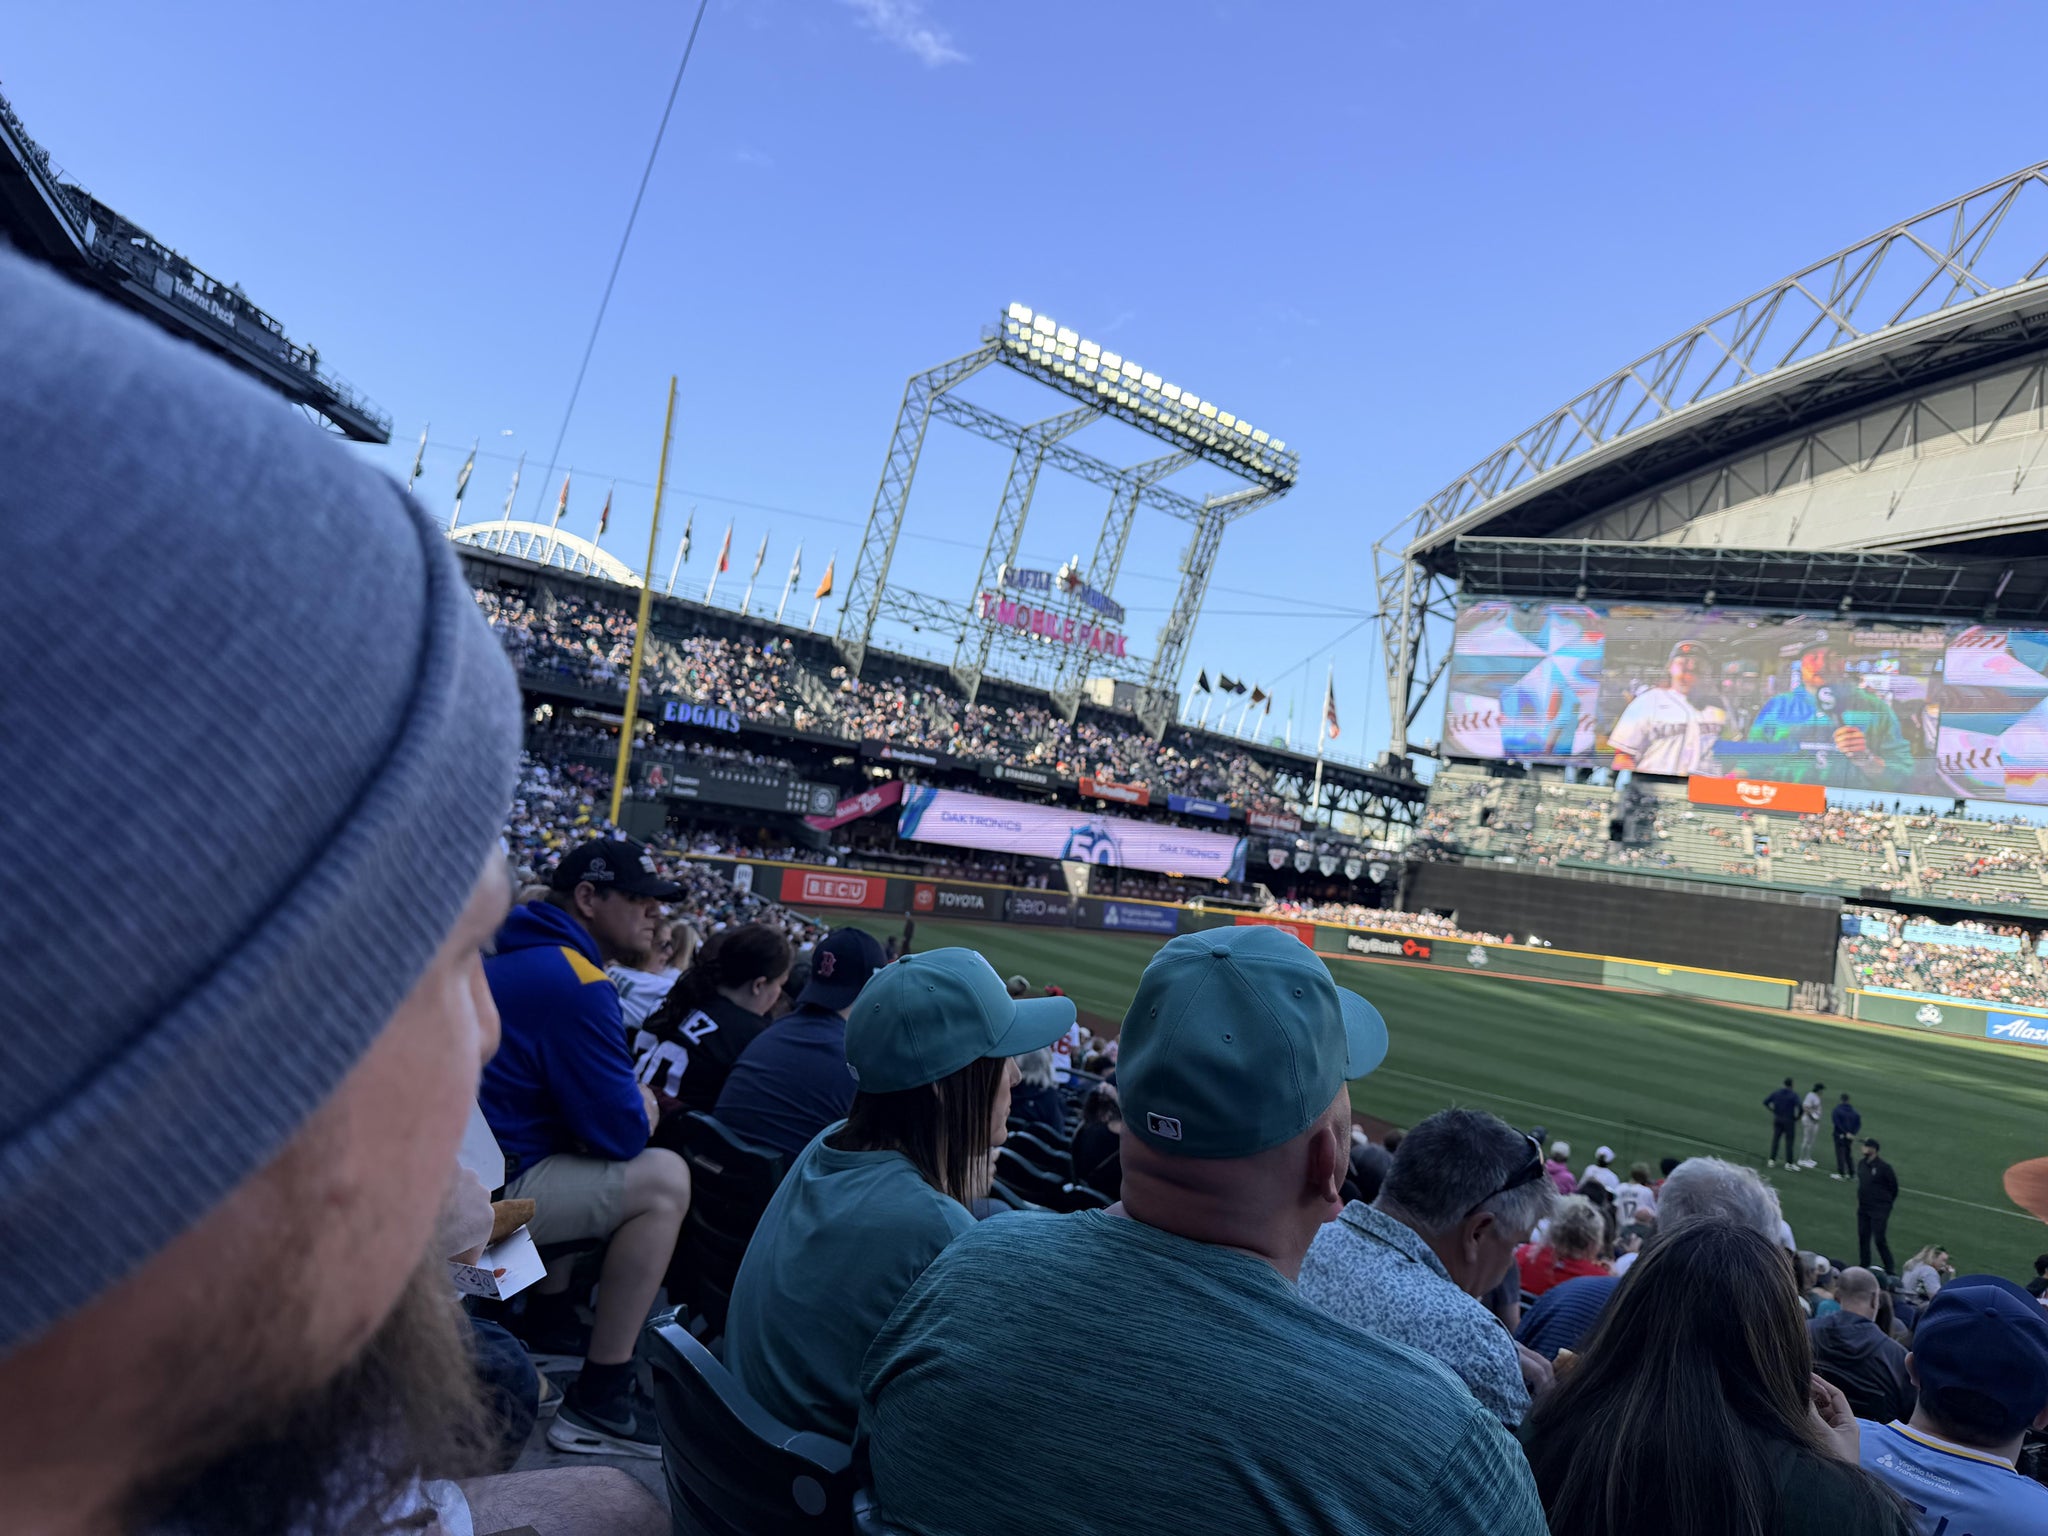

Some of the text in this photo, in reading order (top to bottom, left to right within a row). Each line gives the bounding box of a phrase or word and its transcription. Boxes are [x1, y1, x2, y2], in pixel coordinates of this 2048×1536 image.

[175, 276, 236, 328] Trident Deck
[1079, 624, 1128, 658] PARK
[941, 811, 1021, 832] DAKTRONICS
[808, 881, 862, 898] BECU
[938, 892, 985, 909] TOYOTA
[1347, 934, 1403, 956] KeyBank
[1894, 1465, 1961, 1496] Franciscan Health
[1898, 1459, 1951, 1486] Virginia Mason
